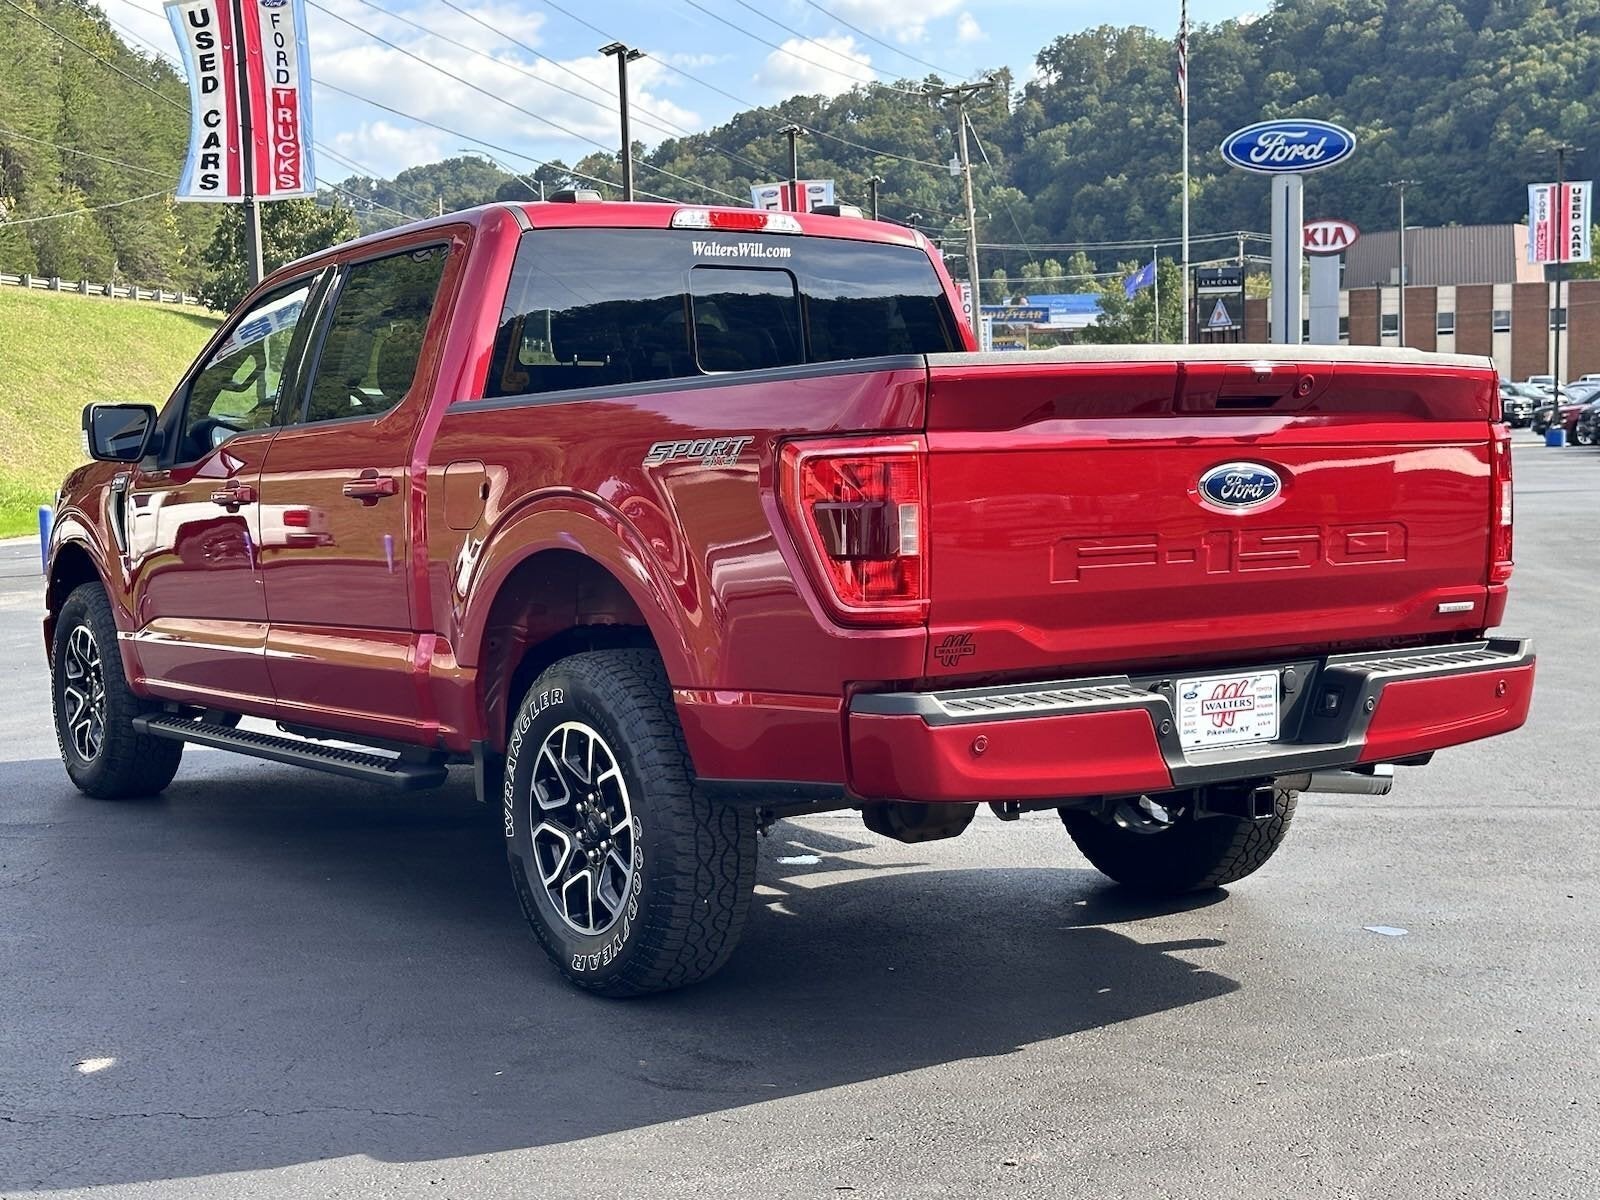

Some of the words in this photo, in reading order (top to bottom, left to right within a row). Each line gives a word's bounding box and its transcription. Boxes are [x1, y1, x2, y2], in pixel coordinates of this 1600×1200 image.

[188, 9, 219, 94] USED
[270, 13, 290, 84] FORD
[199, 109, 221, 190] CARS
[275, 90, 296, 188] TRUCKS
[1250, 131, 1328, 162] Ford
[1572, 188, 1581, 220] USED
[692, 241, 791, 258] WaltersWill.com
[1304, 227, 1348, 246] KIA
[1572, 226, 1581, 257] CARS
[981, 308, 1044, 320] OODYEAR
[642, 436, 755, 468] SPORT
[1220, 473, 1266, 499] Ford
[1050, 521, 1409, 584] F-150
[1205, 699, 1252, 711] WALTERS
[1206, 727, 1238, 737] Pikeville,
[1239, 725, 1250, 733] KY
[503, 688, 564, 838] WRANGLER
[572, 815, 643, 972] GOODYEAR
